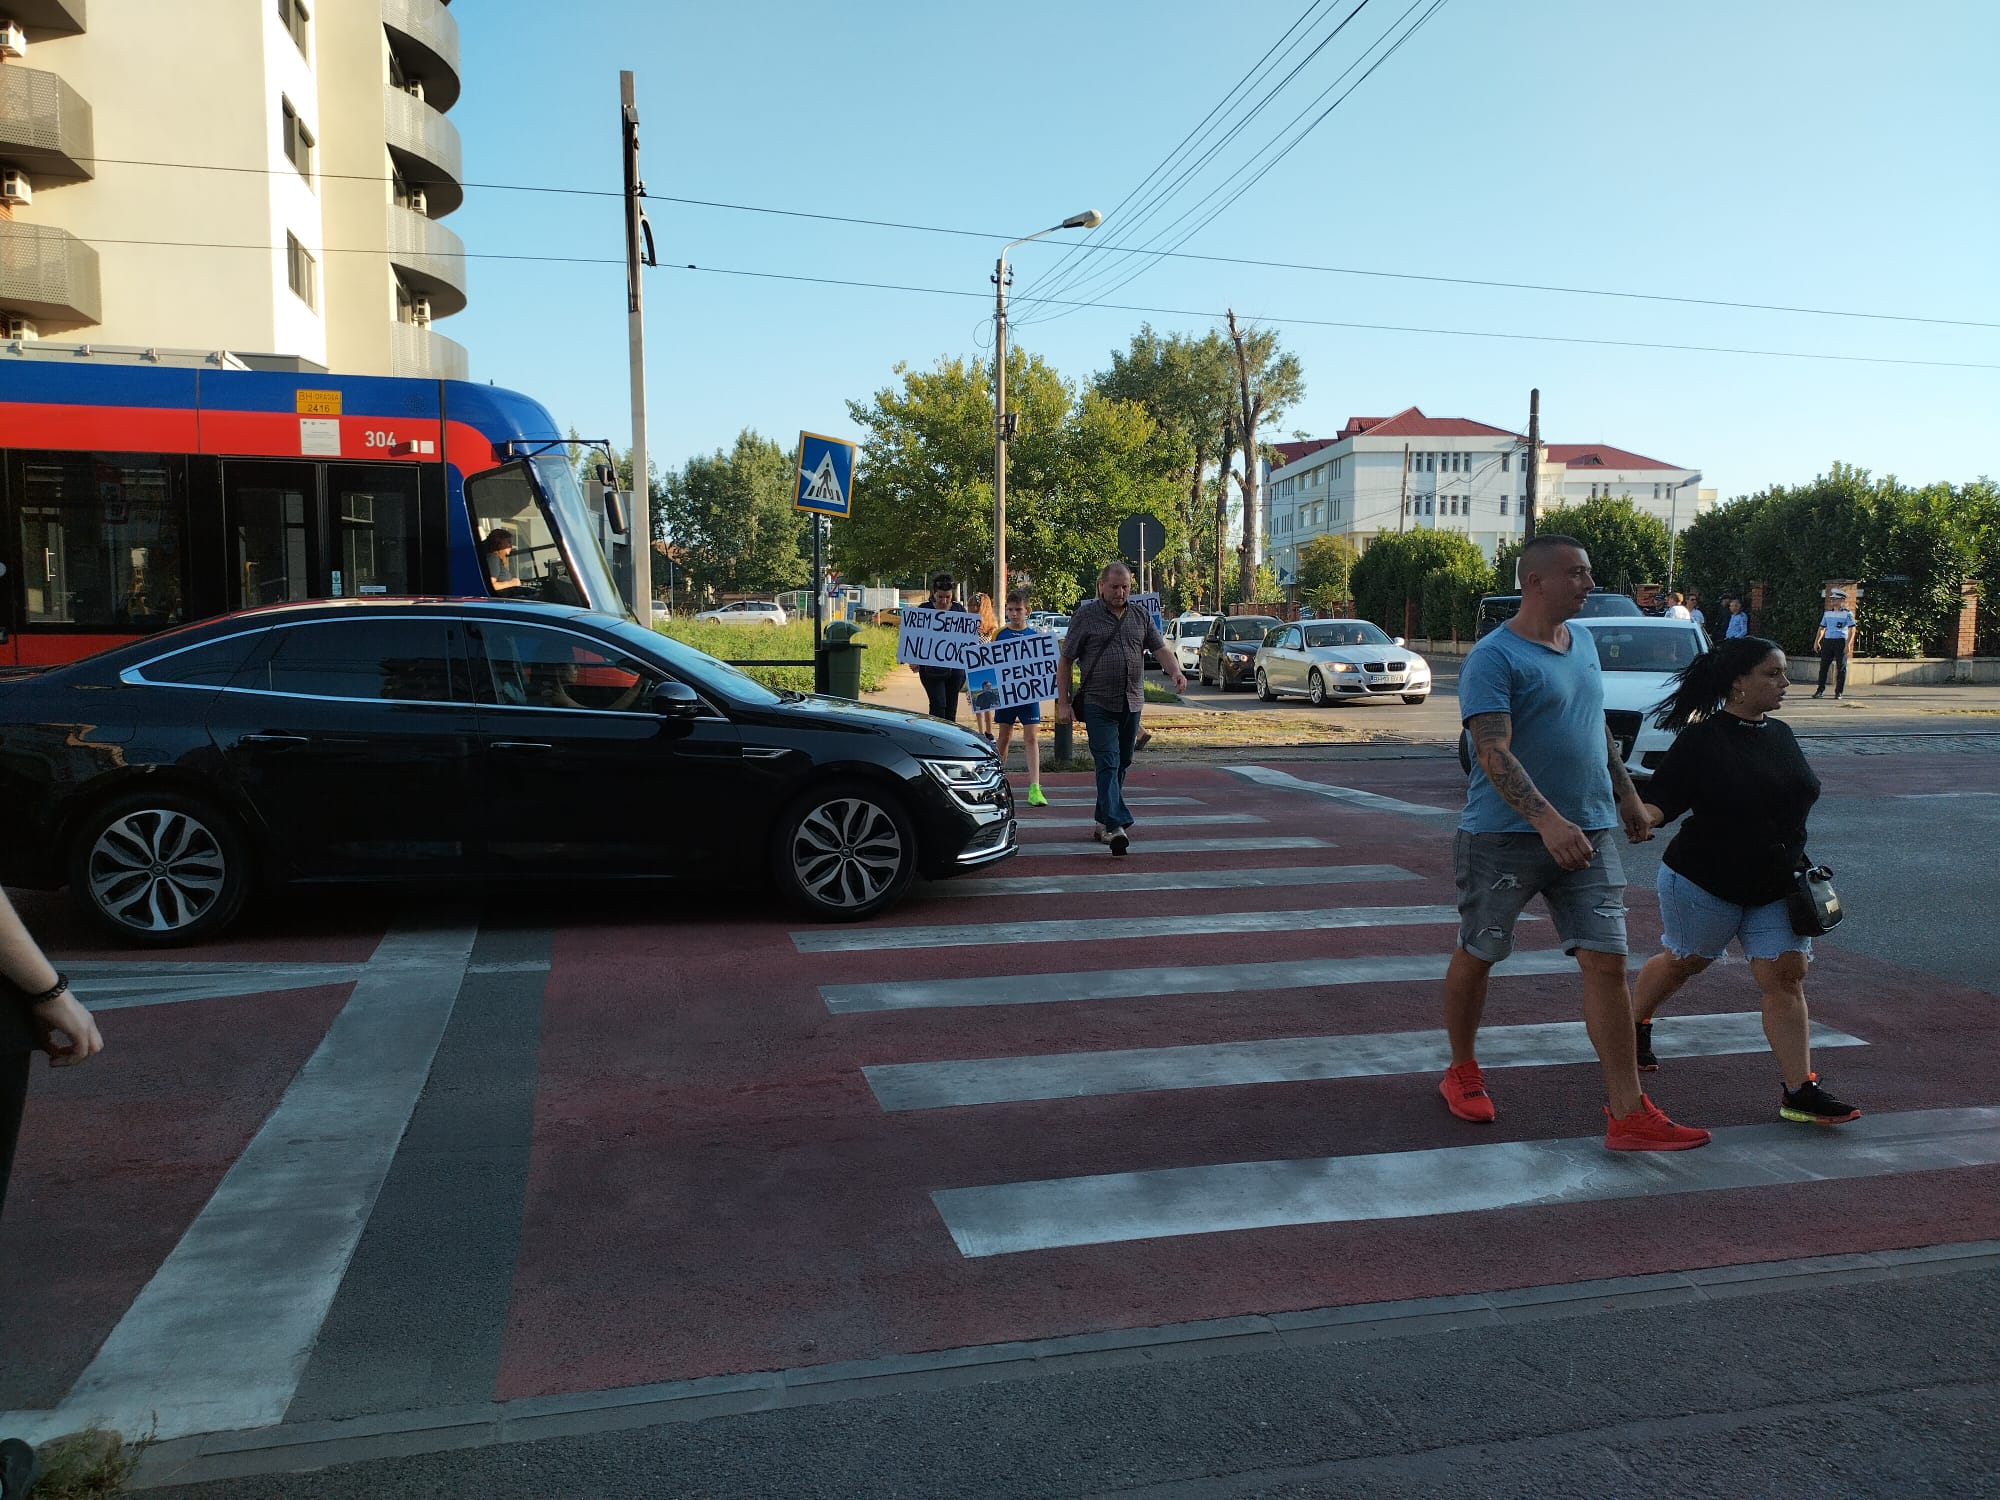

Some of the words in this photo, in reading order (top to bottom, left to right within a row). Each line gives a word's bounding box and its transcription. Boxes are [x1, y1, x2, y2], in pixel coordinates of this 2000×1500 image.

[307, 404, 330, 413] 2416
[364, 430, 397, 448] 304
[902, 610, 932, 630] VREM
[904, 635, 933, 660] NU
[965, 635, 1055, 670] DREPTATE
